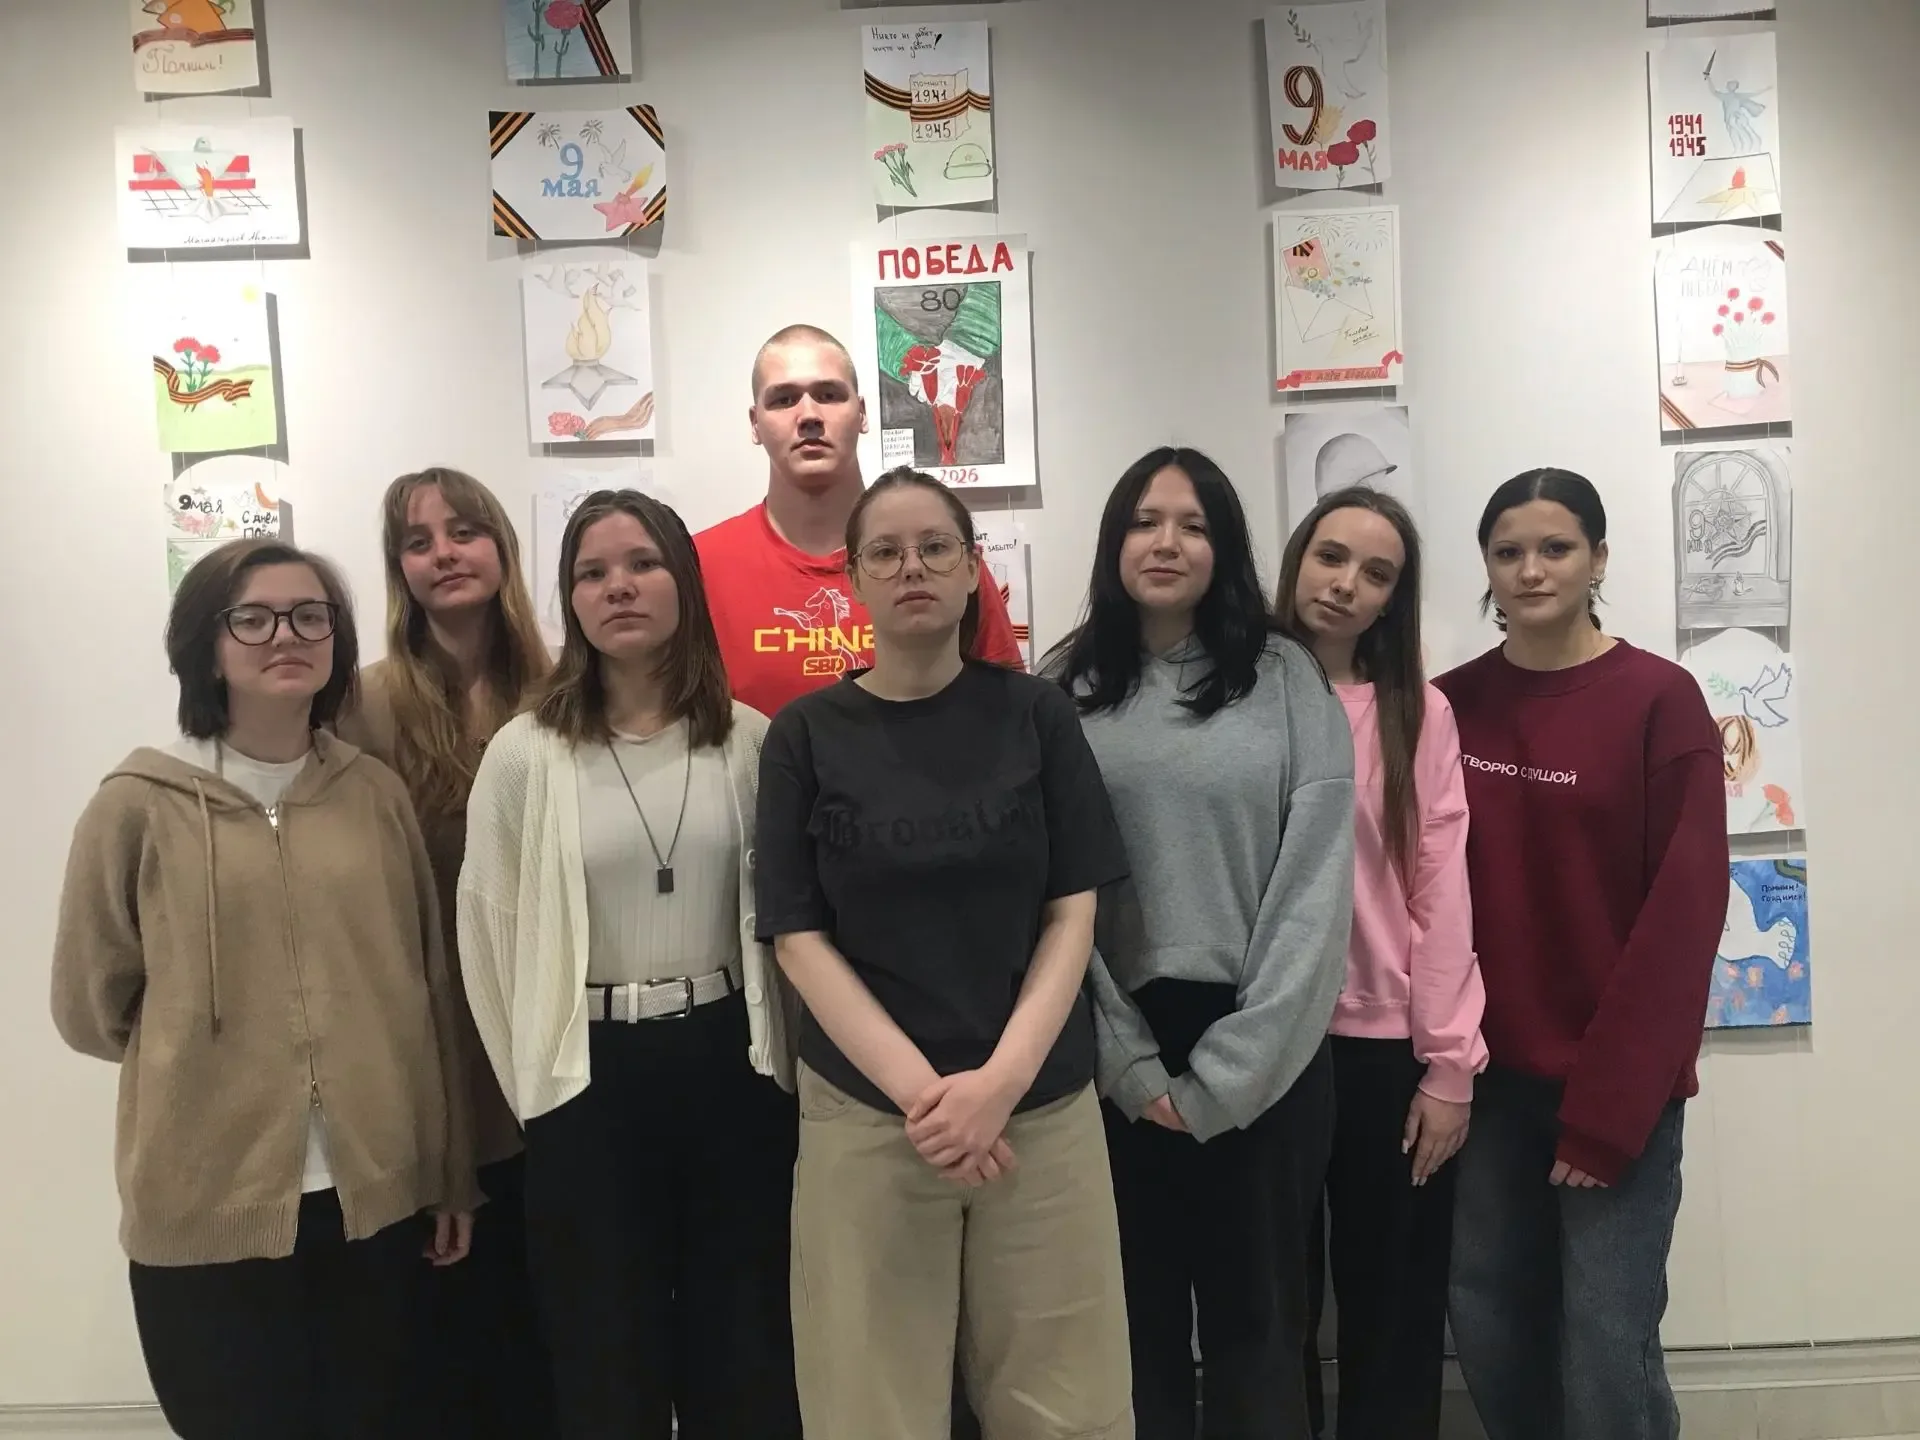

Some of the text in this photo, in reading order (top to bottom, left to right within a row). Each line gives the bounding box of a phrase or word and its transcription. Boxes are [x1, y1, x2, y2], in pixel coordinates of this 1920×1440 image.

[914, 89, 948, 103] 1941
[1282, 65, 1324, 146] 9
[915, 119, 951, 139] 1945
[1668, 113, 1703, 135] 1941
[1669, 136, 1707, 157] 1945
[560, 143, 584, 180] 9
[1278, 147, 1328, 171] МАЯ
[878, 242, 1014, 280] ПОБЕДА
[920, 288, 961, 312] 80
[940, 468, 979, 484] 2026
[1689, 509, 1706, 541] 9
[805, 658, 844, 674] SBD
[1462, 754, 1518, 776] ТВОРЮ
[1528, 767, 1578, 785] ДУШОЙ
[1726, 783, 1743, 797] АЯ
